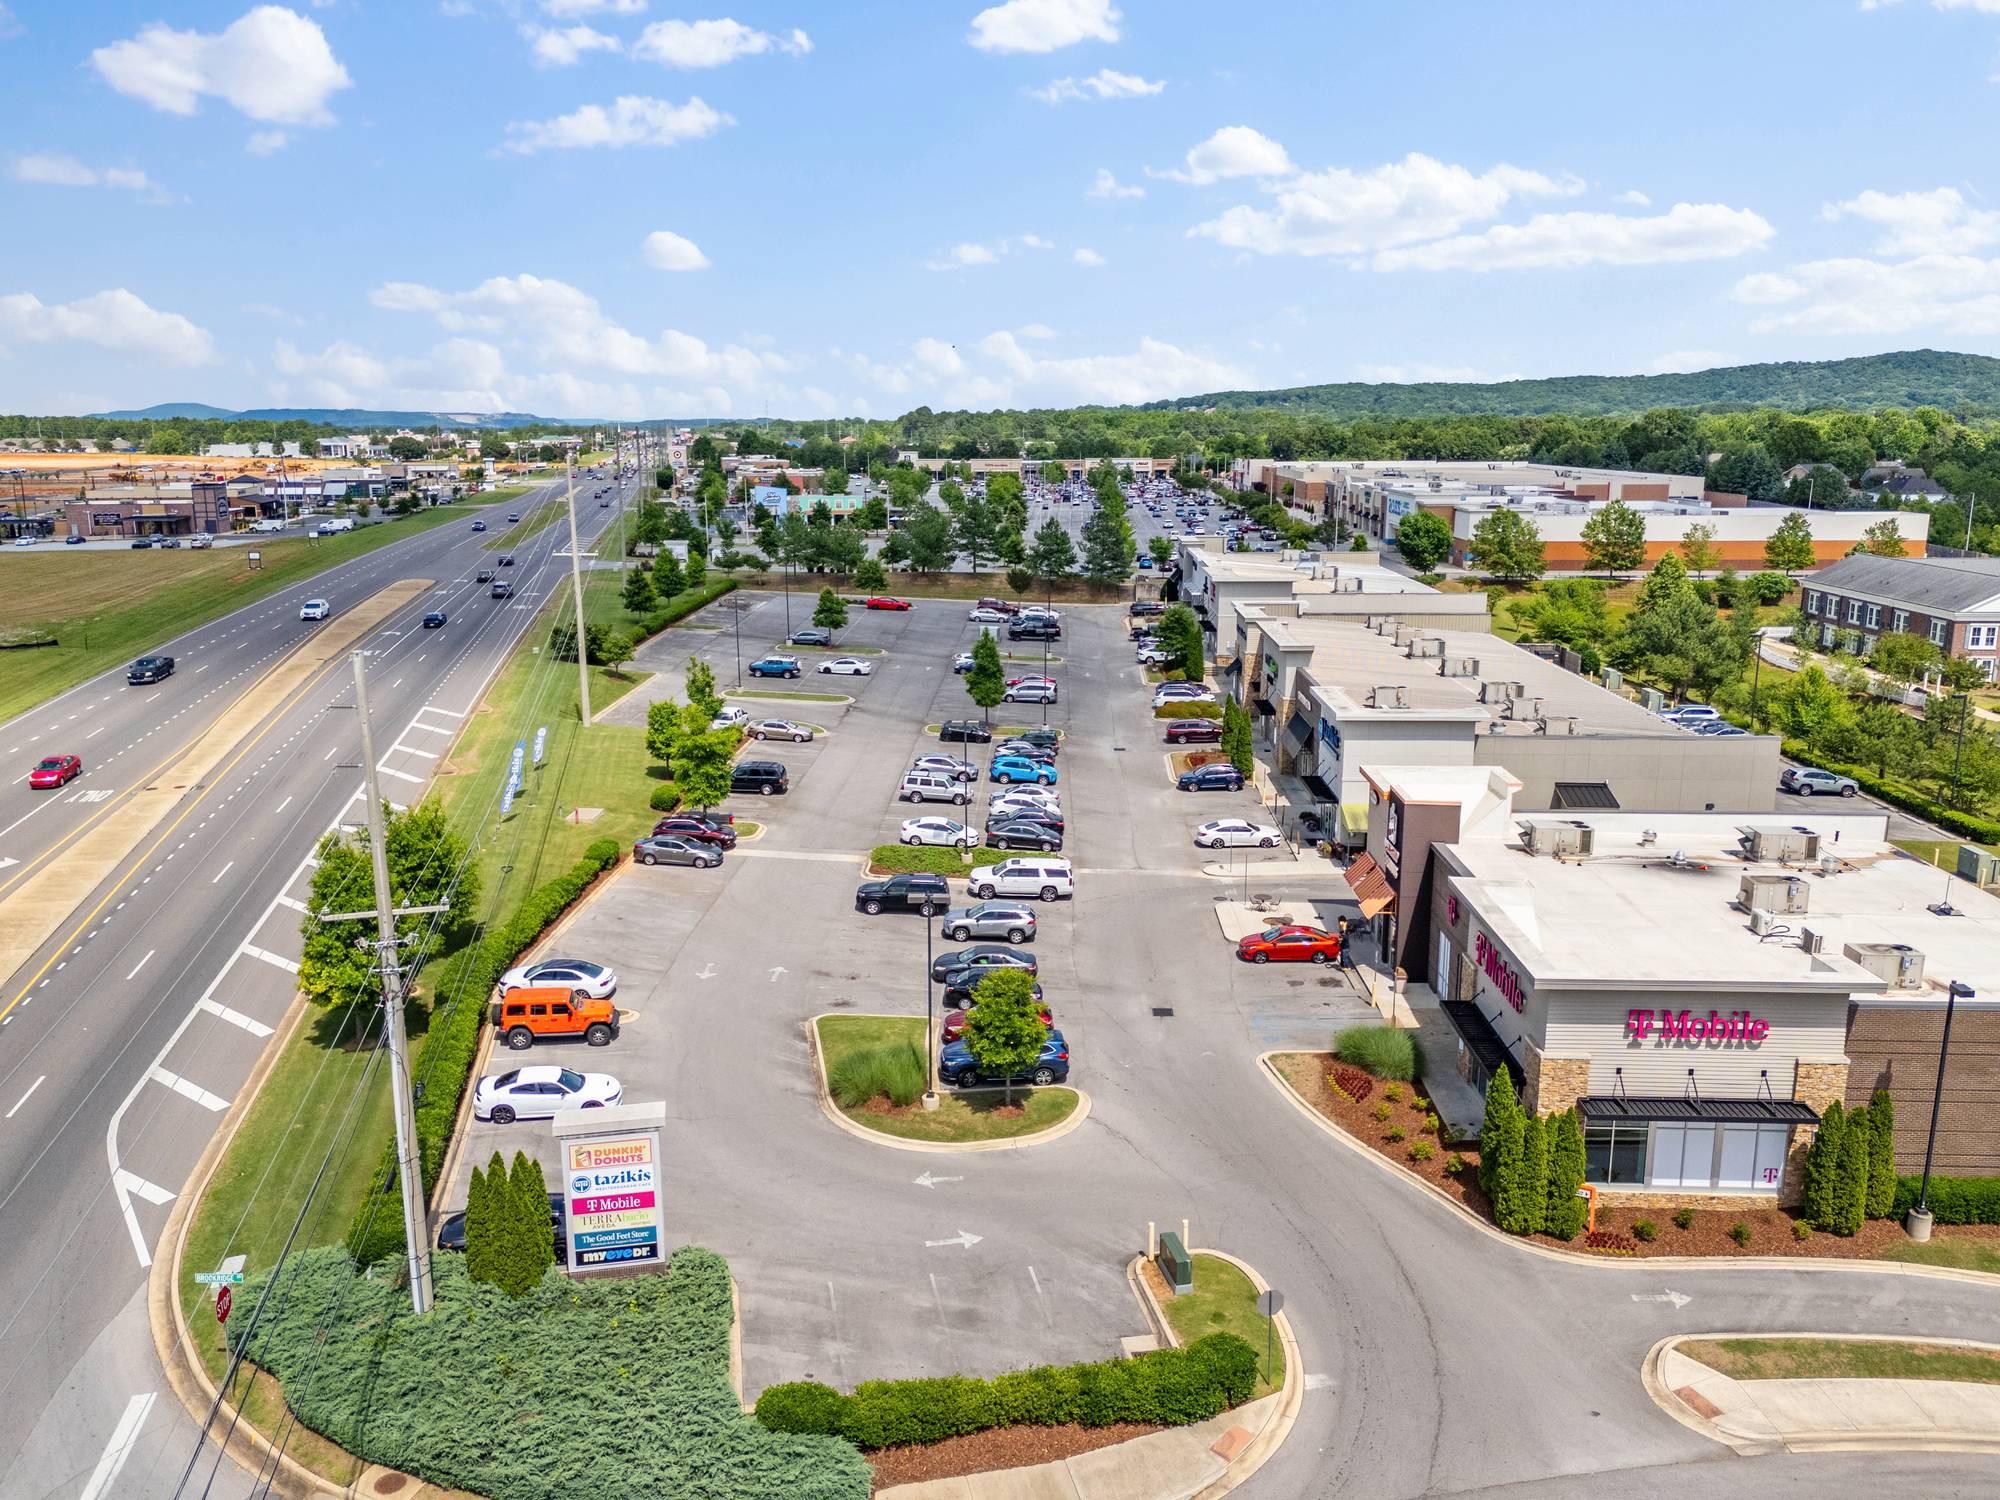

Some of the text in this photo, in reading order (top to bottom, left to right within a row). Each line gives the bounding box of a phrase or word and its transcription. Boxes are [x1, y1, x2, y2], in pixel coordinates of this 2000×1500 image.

[1661, 1010, 1770, 1041] Mobile
[594, 1145, 646, 1157] DUNKIN'
[594, 1154, 643, 1165] DONUTS
[594, 1169, 651, 1186] tazikis
[600, 1196, 641, 1210] Mobile
[582, 1230, 650, 1243] The Good Feet Store
[217, 1293, 231, 1317] STOP
